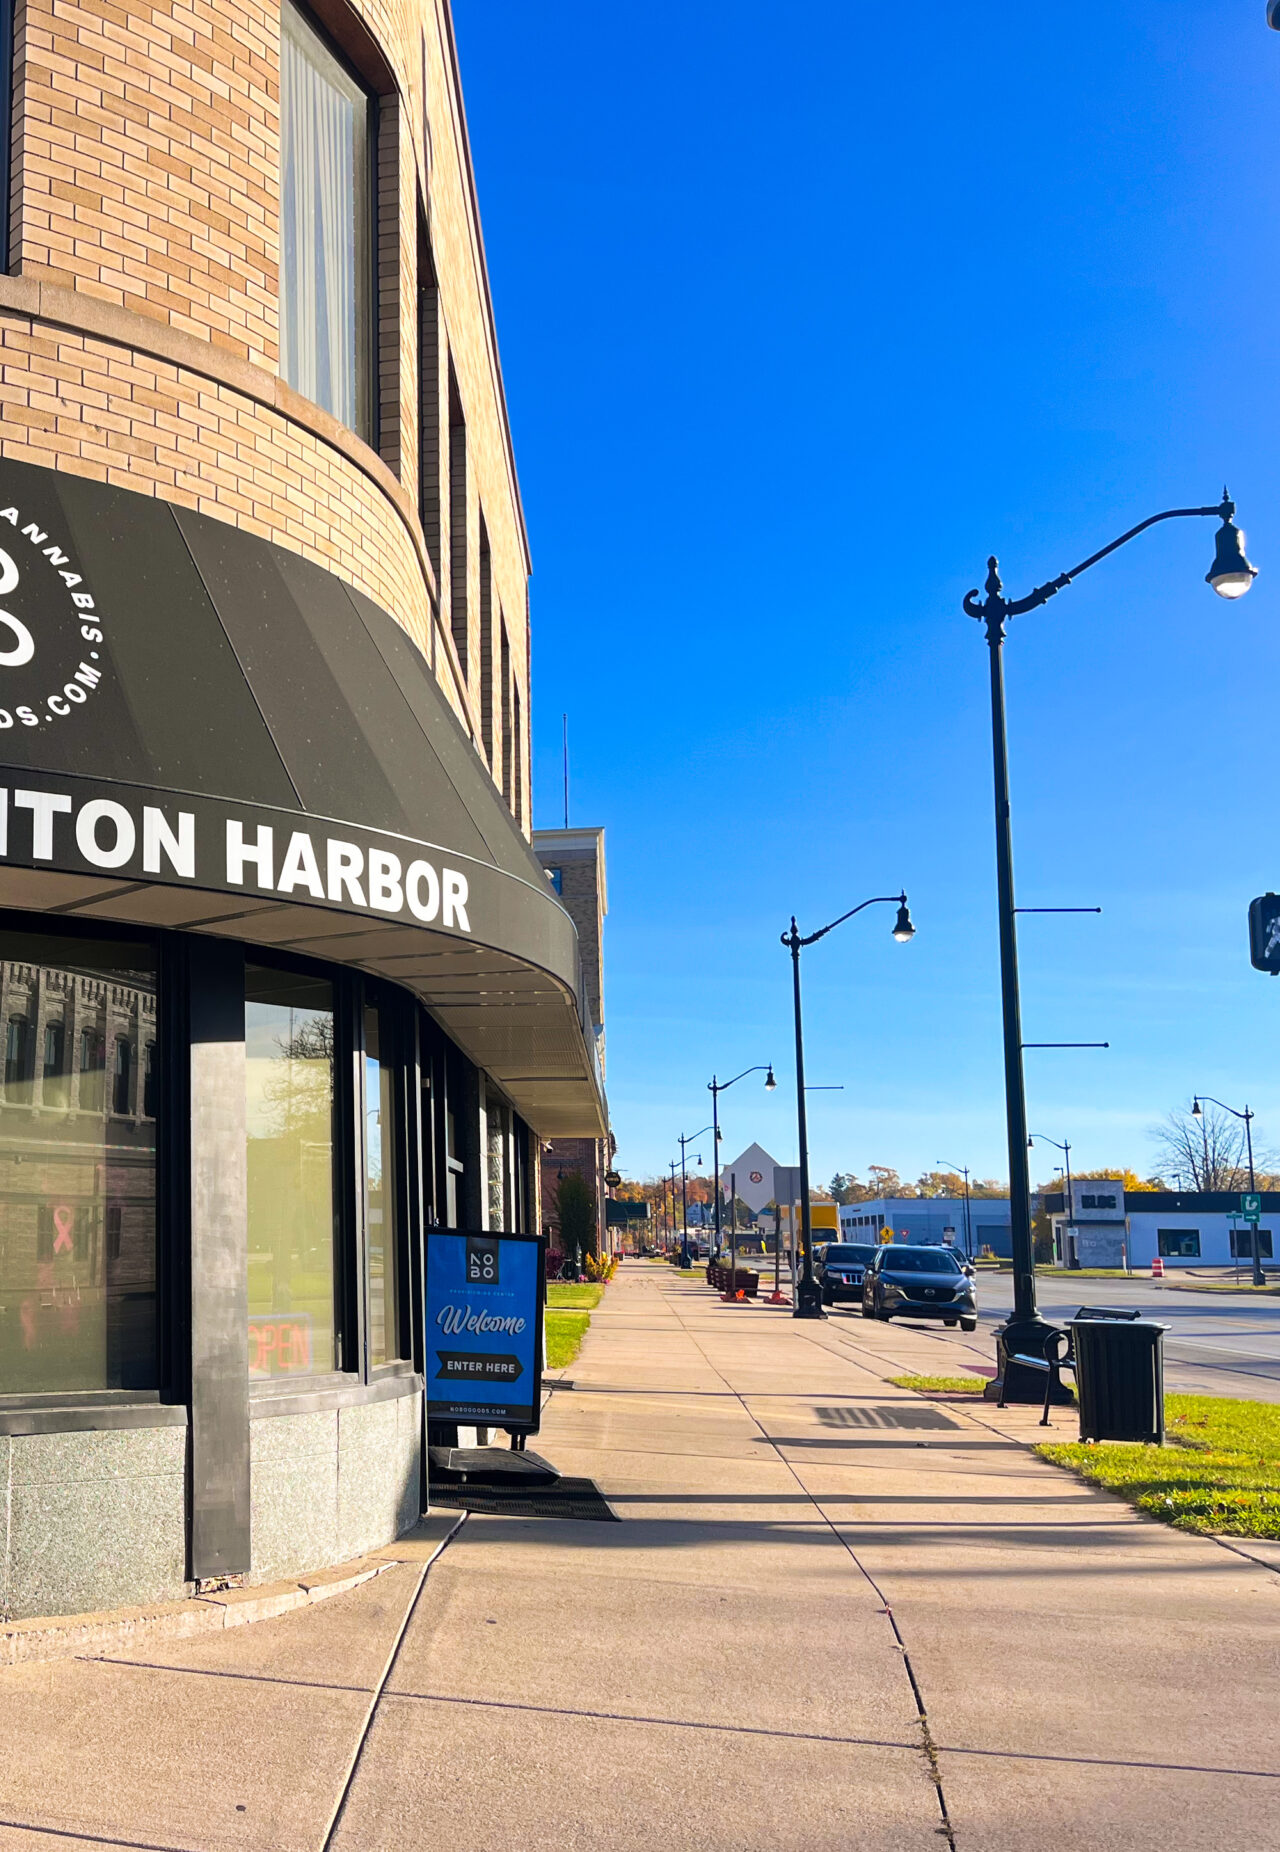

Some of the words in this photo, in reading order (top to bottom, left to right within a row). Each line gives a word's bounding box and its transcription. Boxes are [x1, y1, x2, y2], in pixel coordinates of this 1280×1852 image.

[224, 818, 472, 933] HARBOR
[436, 1304, 526, 1336] Welcome
[447, 1360, 483, 1372] ENTER
[486, 1362, 516, 1374] HERE
